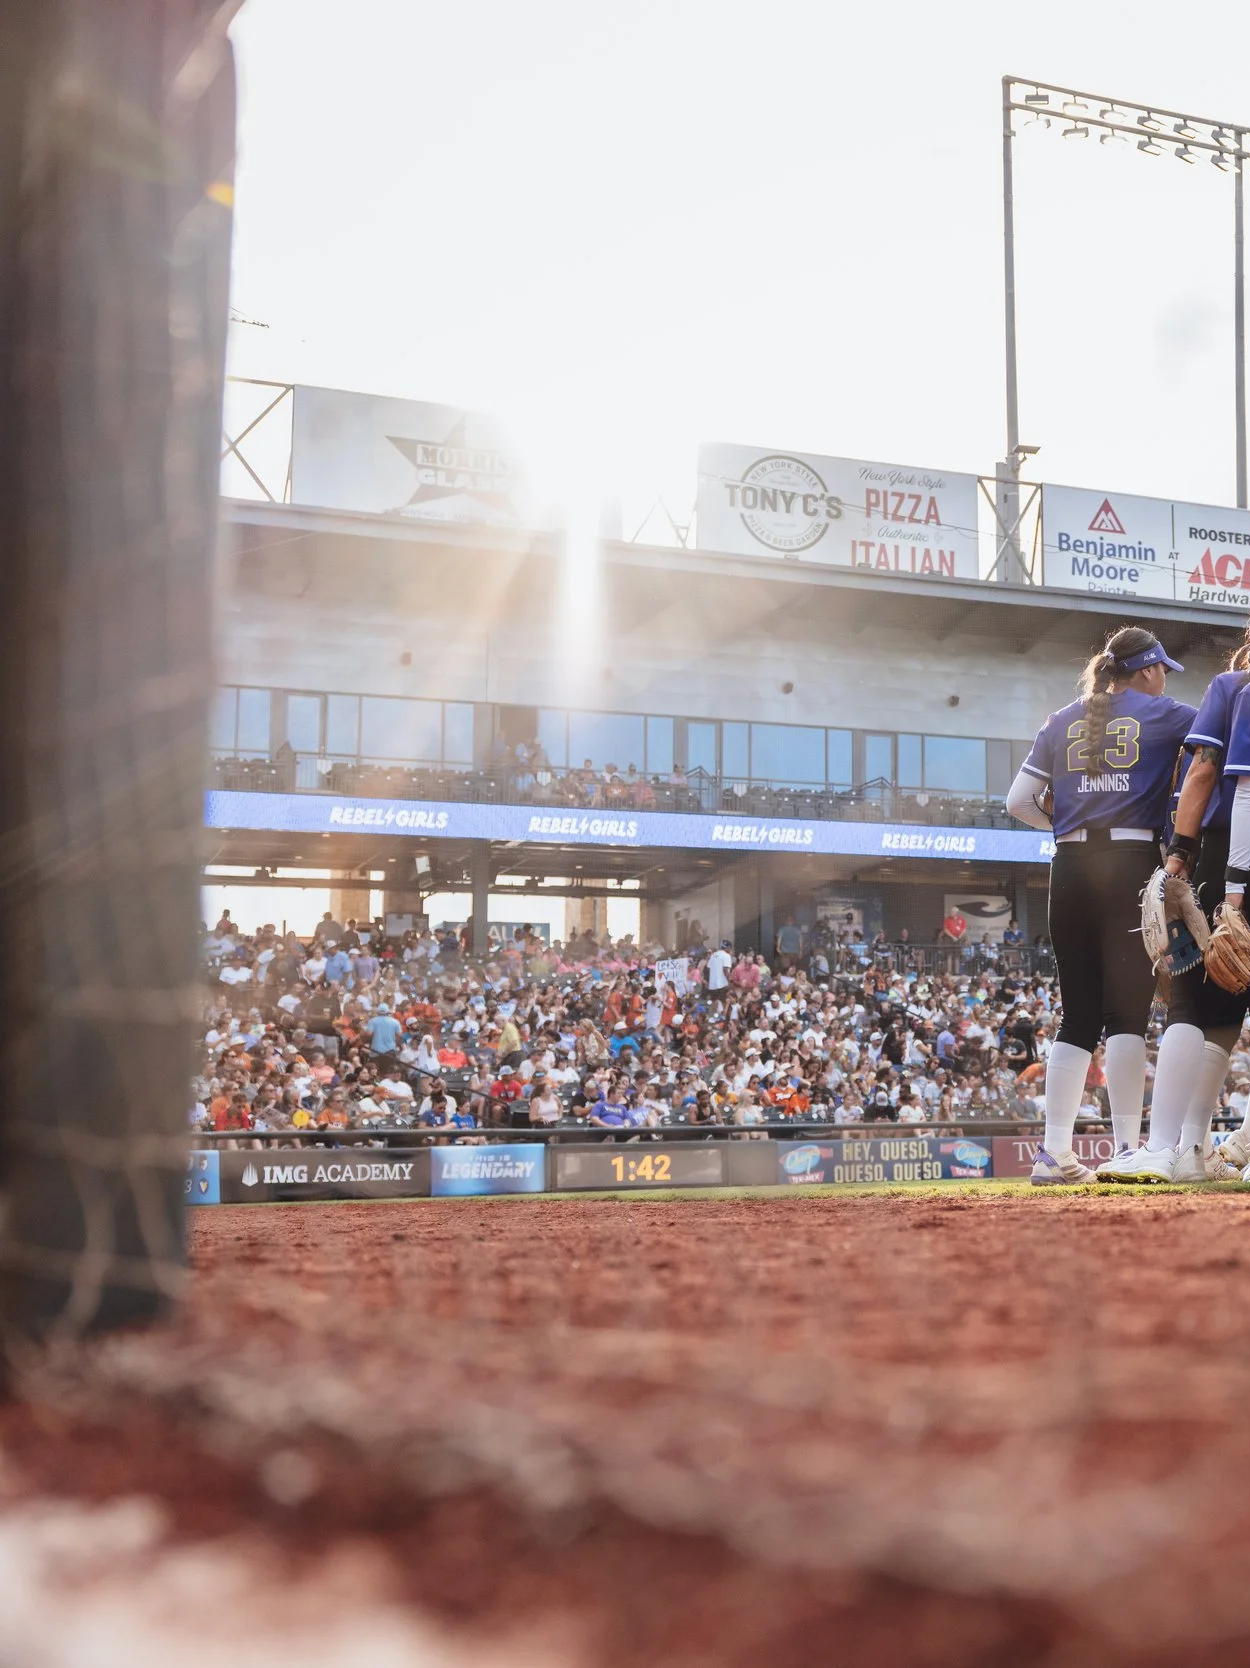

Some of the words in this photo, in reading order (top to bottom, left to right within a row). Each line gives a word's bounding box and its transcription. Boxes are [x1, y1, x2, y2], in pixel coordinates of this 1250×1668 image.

[751, 464, 767, 480] NEW
[770, 461, 792, 469] YORK
[795, 466, 819, 488] STYLE
[859, 467, 886, 481] New
[886, 470, 917, 486] York
[917, 475, 948, 490] Style
[724, 484, 796, 514] TONY
[802, 492, 842, 519] C'S
[865, 487, 942, 526] PIZZA
[877, 525, 928, 542] Authentic
[1058, 532, 1156, 561] Benjamin
[1168, 552, 1180, 560] AT
[1071, 557, 1139, 583] Moore
[1088, 582, 1125, 596] Paint
[1067, 716, 1141, 772] 23
[1078, 773, 1130, 792] JENNINGS
[329, 806, 384, 825] REBEL
[395, 809, 449, 829] GIRLS
[528, 816, 580, 834] REBEL
[589, 818, 638, 838] GIRLS
[712, 825, 760, 842] REBEL
[768, 827, 813, 845] GIRLS
[881, 833, 928, 850] REBEL
[934, 835, 976, 853] GIRLS
[842, 1142, 874, 1162] HEY,
[880, 1141, 932, 1162] QUESO,
[263, 1165, 308, 1184] IMG
[312, 1163, 415, 1183] ACADEMY
[442, 1161, 535, 1179] LEGENDARY
[611, 1154, 671, 1182] 1:42
[834, 1164, 888, 1183] QUESO,
[893, 1161, 942, 1180] QUESO
